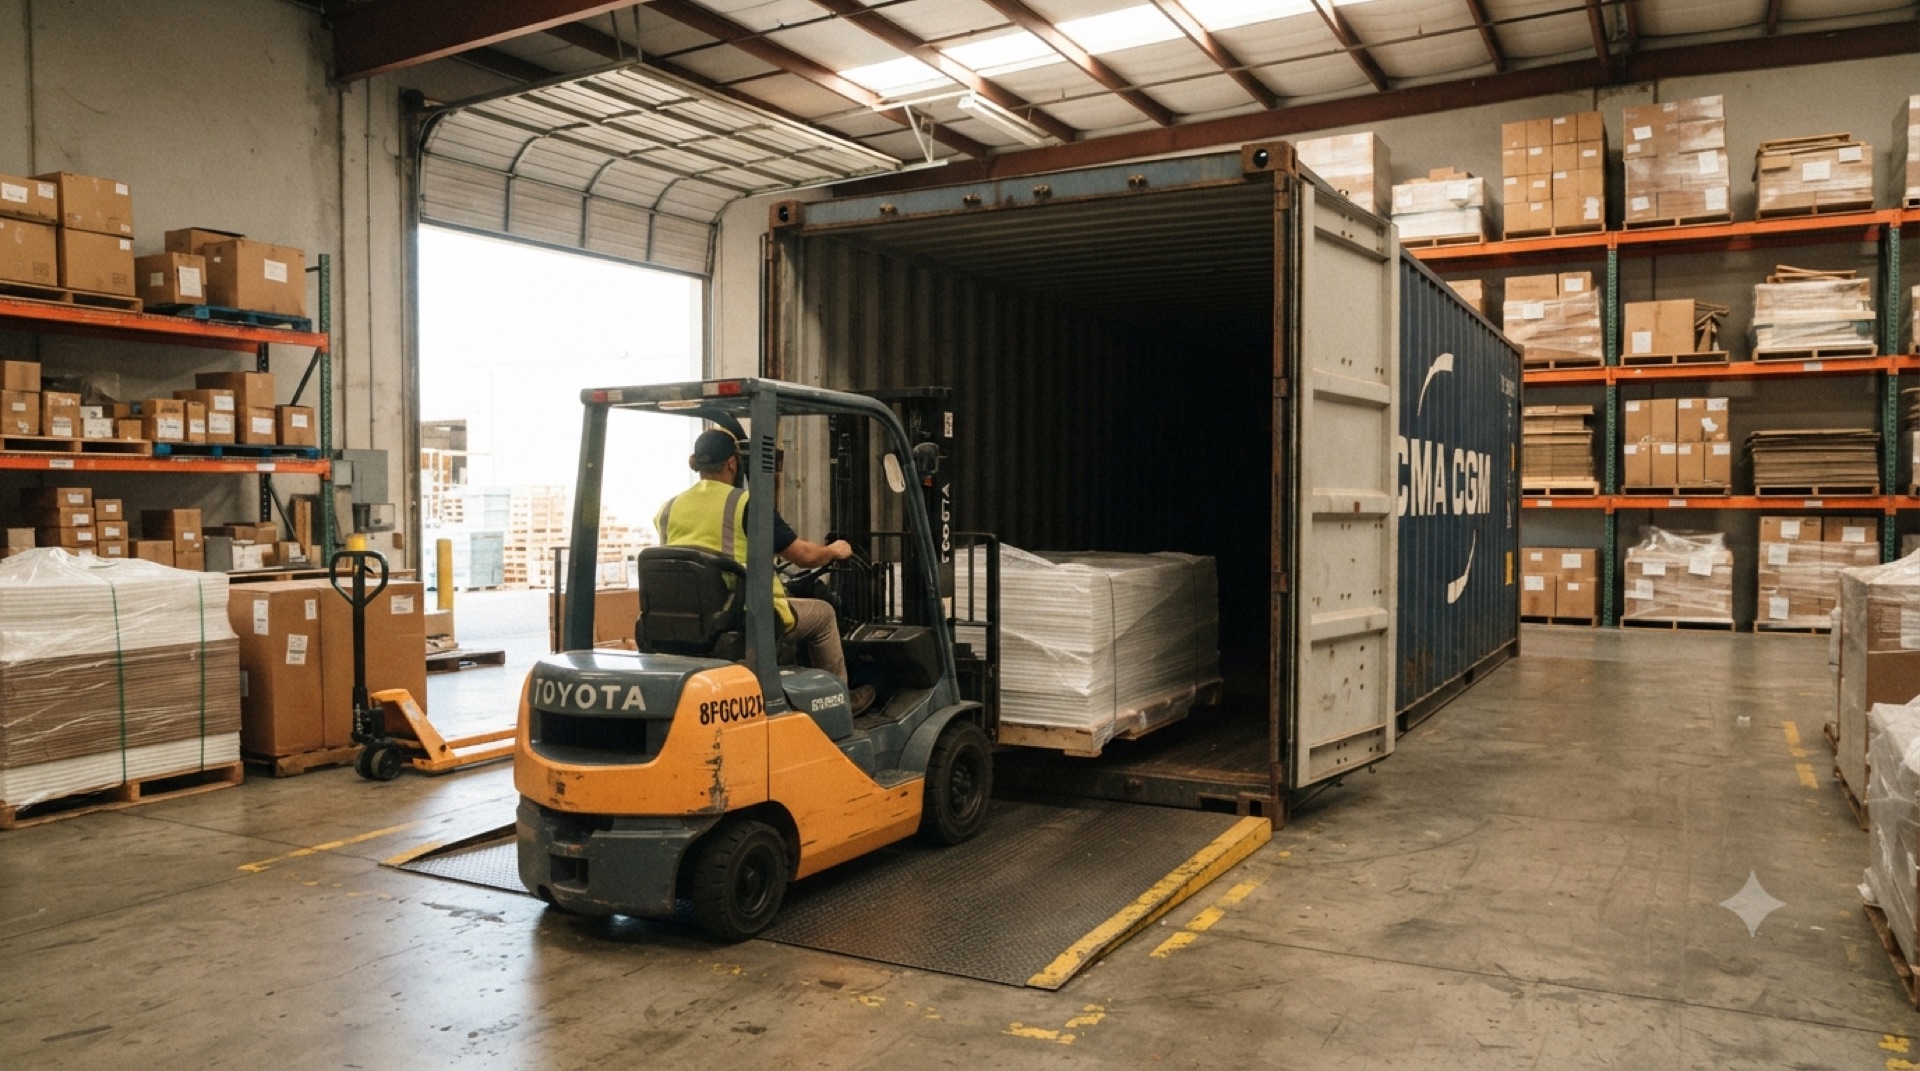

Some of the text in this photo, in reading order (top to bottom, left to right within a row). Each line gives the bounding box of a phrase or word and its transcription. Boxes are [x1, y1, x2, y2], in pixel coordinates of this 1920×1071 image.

[1398, 435, 1491, 517] CMA CGM
[534, 678, 646, 711] TOYOTA
